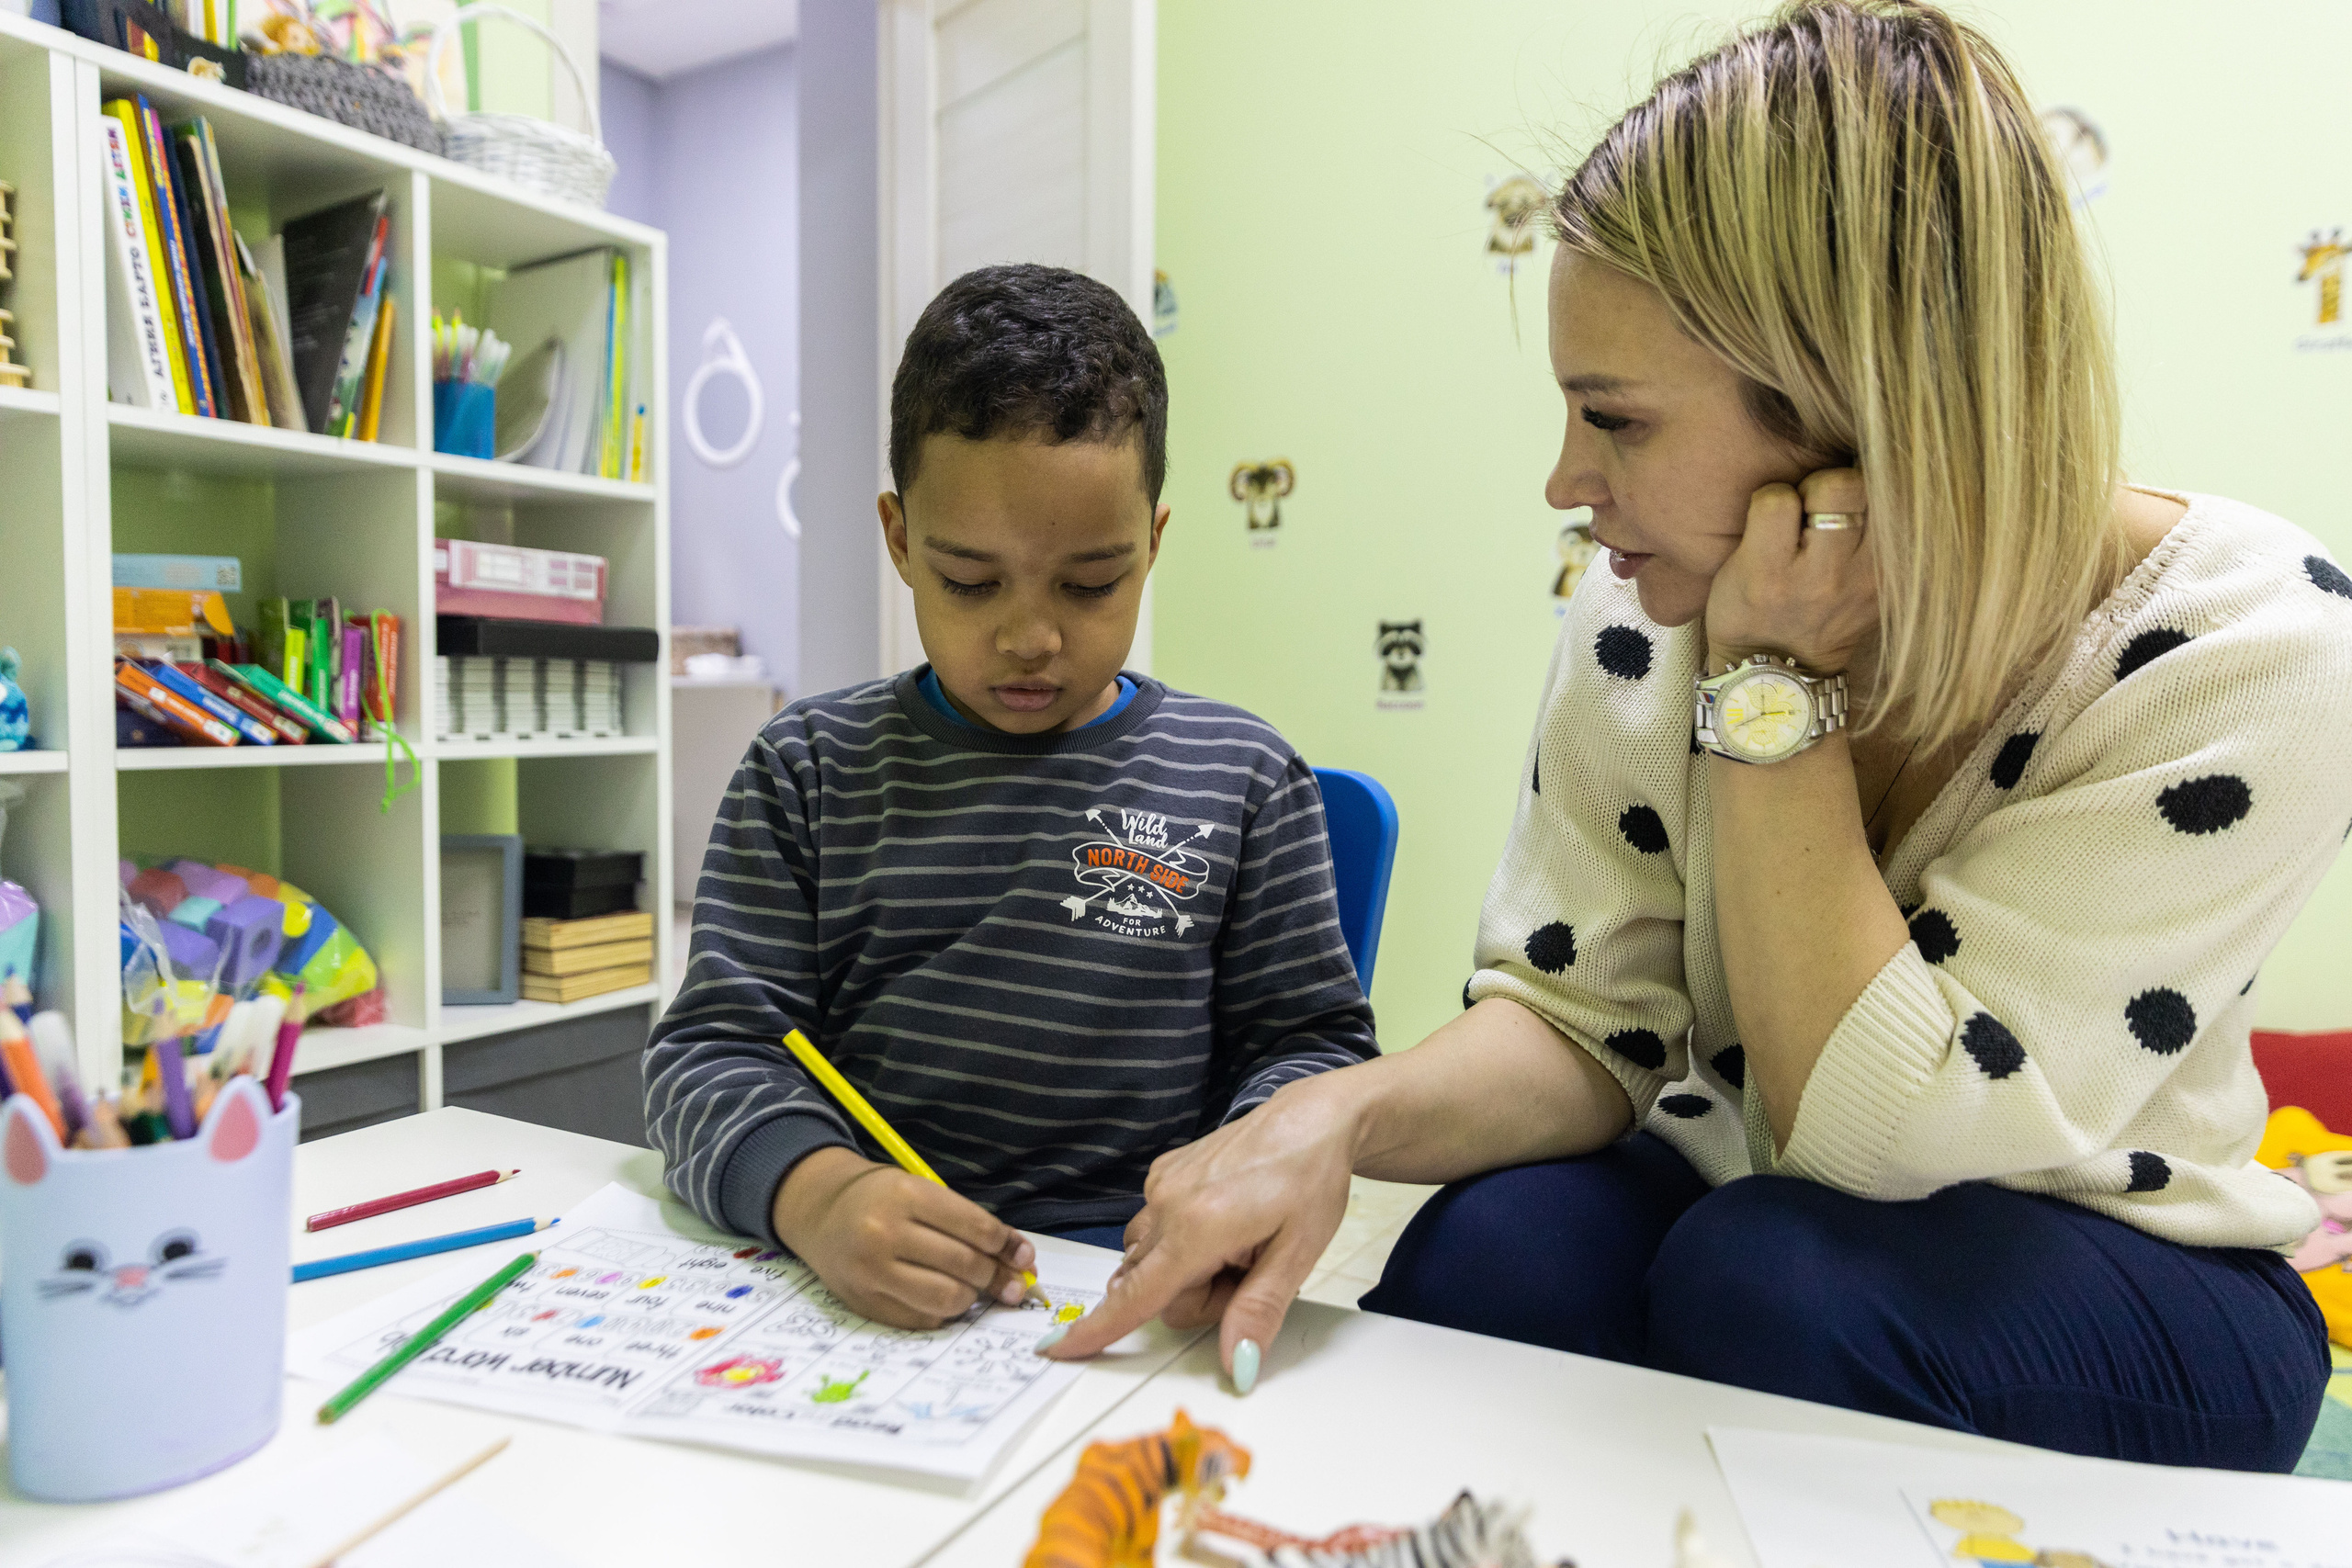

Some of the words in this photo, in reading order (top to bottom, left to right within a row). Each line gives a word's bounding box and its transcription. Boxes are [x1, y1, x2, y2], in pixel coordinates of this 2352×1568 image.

[130, 245, 151, 311] БАРТО
[143, 314, 165, 379] АГНИЯ
[1120, 808, 1168, 836] Wild
[1128, 828, 1169, 850] Land
[1088, 847, 1149, 875] NORTH
[1149, 864, 1191, 894] SIDE
[1094, 915, 1167, 937] ADVENTURE
[1123, 918, 1141, 927] FOR
[677, 1255, 729, 1271] eight
[750, 1266, 788, 1283] five
[503, 1280, 537, 1294] tw
[554, 1286, 611, 1302] seven
[624, 1293, 671, 1313] four
[695, 1300, 737, 1315] nine
[563, 1334, 604, 1348] one
[511, 1357, 643, 1391] Number
